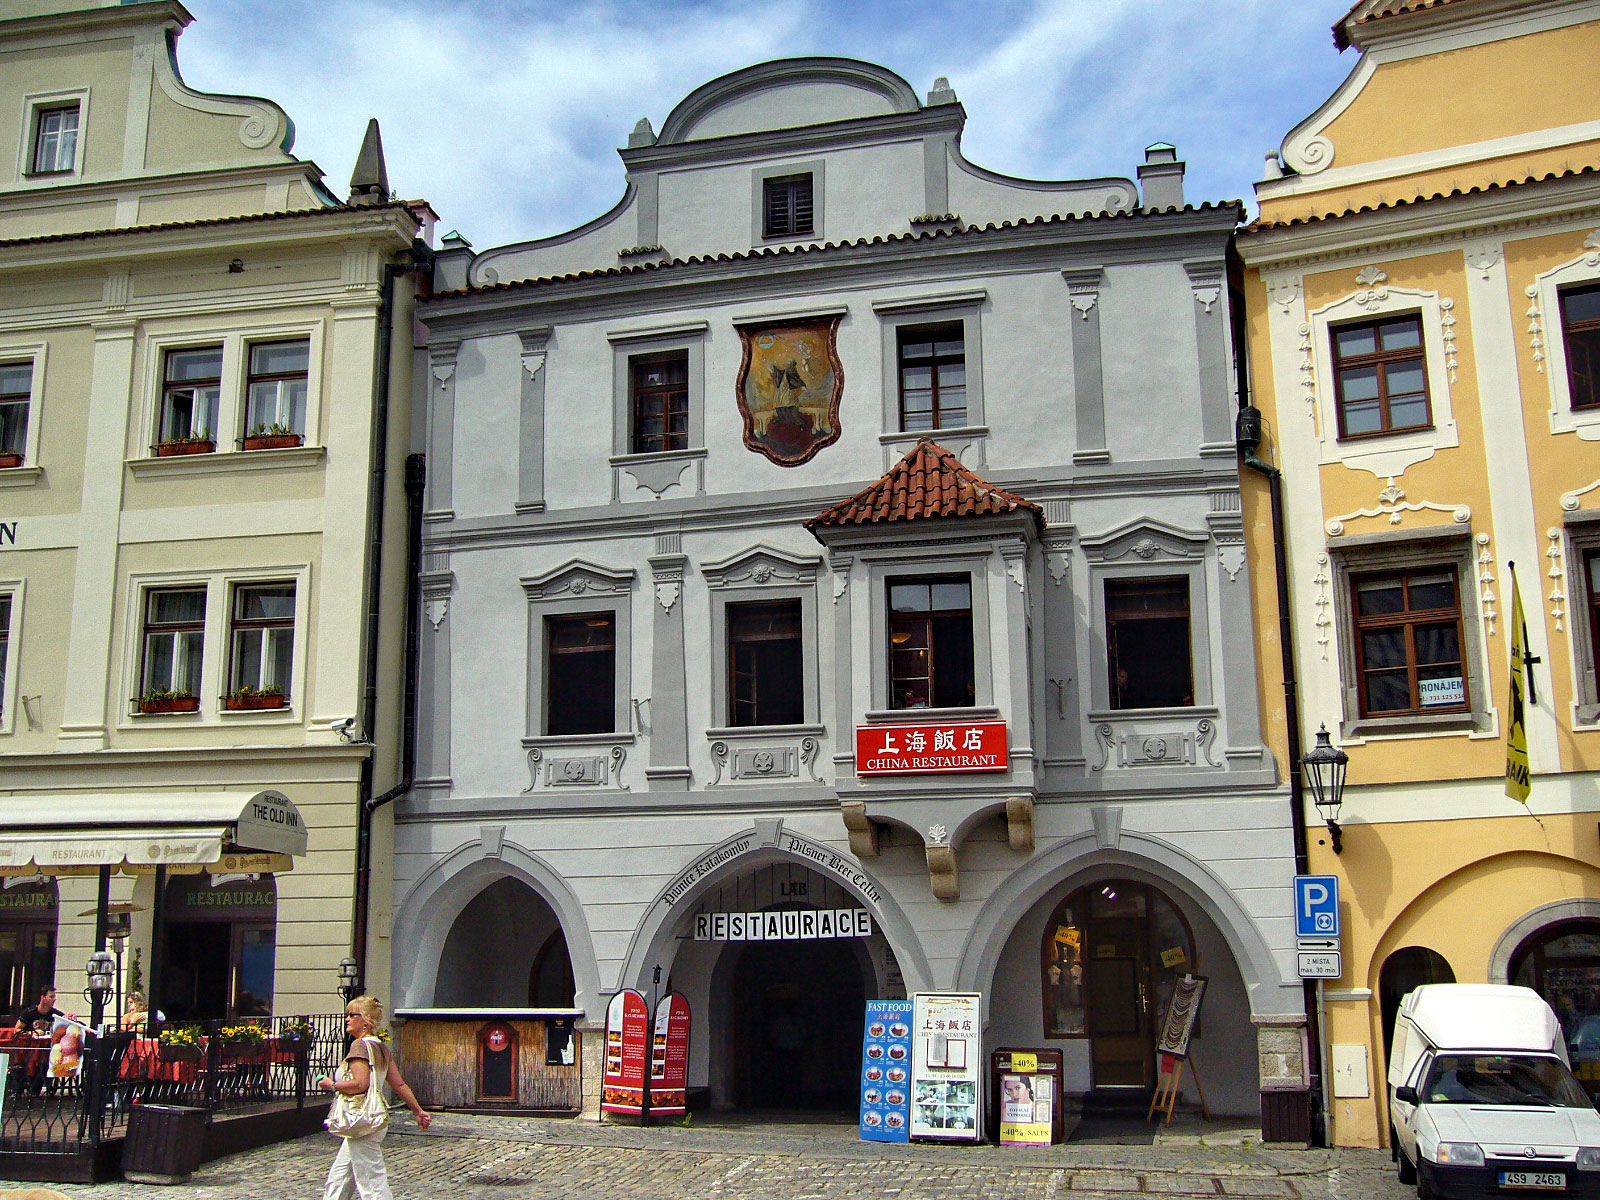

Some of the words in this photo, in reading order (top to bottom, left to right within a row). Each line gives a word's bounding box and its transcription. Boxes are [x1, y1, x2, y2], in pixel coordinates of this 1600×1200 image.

[877, 727, 984, 755] 上海飯店
[866, 757, 910, 770] CHINA
[912, 754, 998, 768] RESTAURANT
[253, 803, 268, 820] THE
[269, 807, 285, 823] OLD
[285, 811, 298, 827] INN
[52, 849, 107, 859] RESTAURANT
[787, 837, 828, 863] Pilsner
[827, 854, 853, 878] Beer
[852, 873, 882, 903] Cellar
[1304, 884, 1329, 917] P
[697, 911, 869, 938] RESTAURACE
[867, 1002, 886, 1012] FAST
[887, 1003, 912, 1012] FOOD
[922, 1019, 972, 1031] 上海飯店
[1013, 1059, 1035, 1068] -40%
[1002, 1128, 1024, 1137] -40%
[1507, 1173, 1527, 1184] 4S9
[1534, 1174, 1561, 1185] 2463
